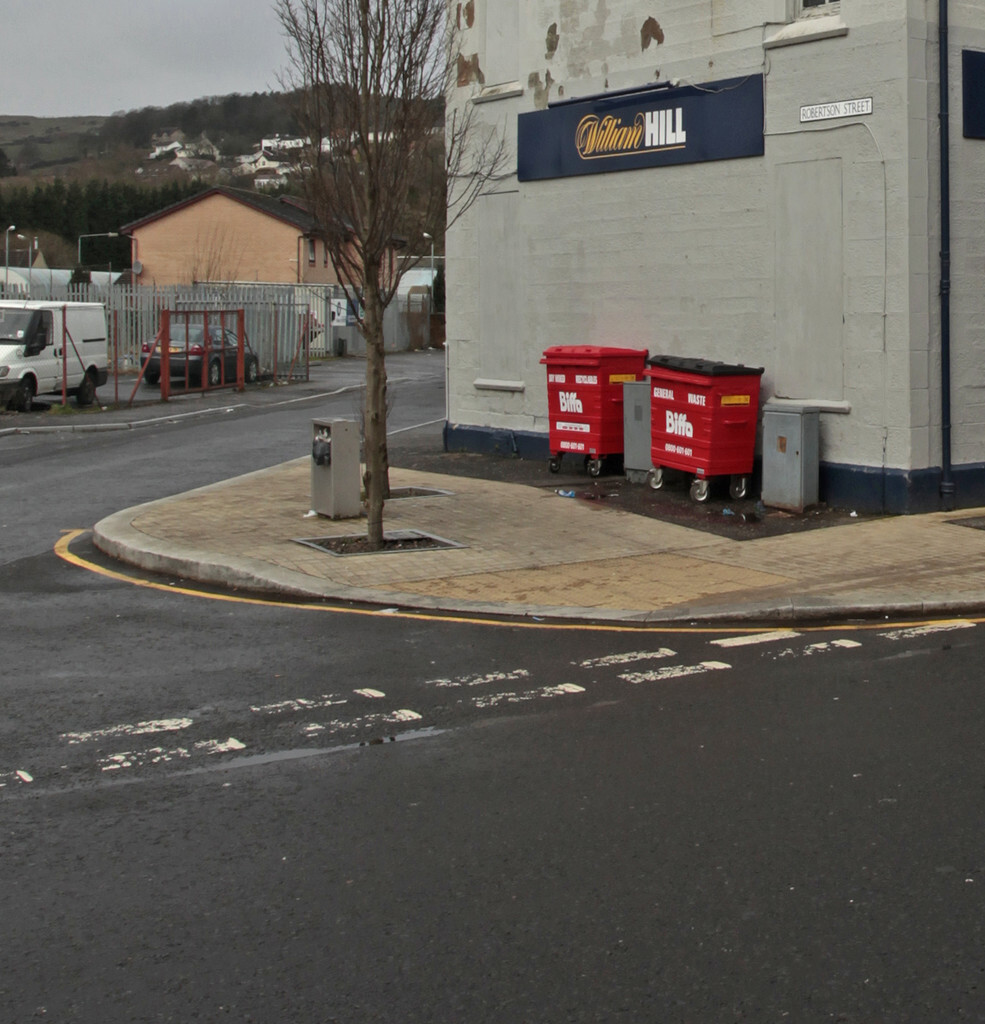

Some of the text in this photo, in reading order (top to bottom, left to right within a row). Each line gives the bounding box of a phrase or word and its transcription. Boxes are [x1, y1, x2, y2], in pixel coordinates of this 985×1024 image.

[802, 100, 870, 120] ROBERTSON STREET
[575, 107, 686, 156] William HILL
[559, 391, 583, 414] Biffa
[653, 387, 675, 401] GENERAL
[688, 393, 706, 407] WASTE
[665, 409, 694, 438] Biffa
